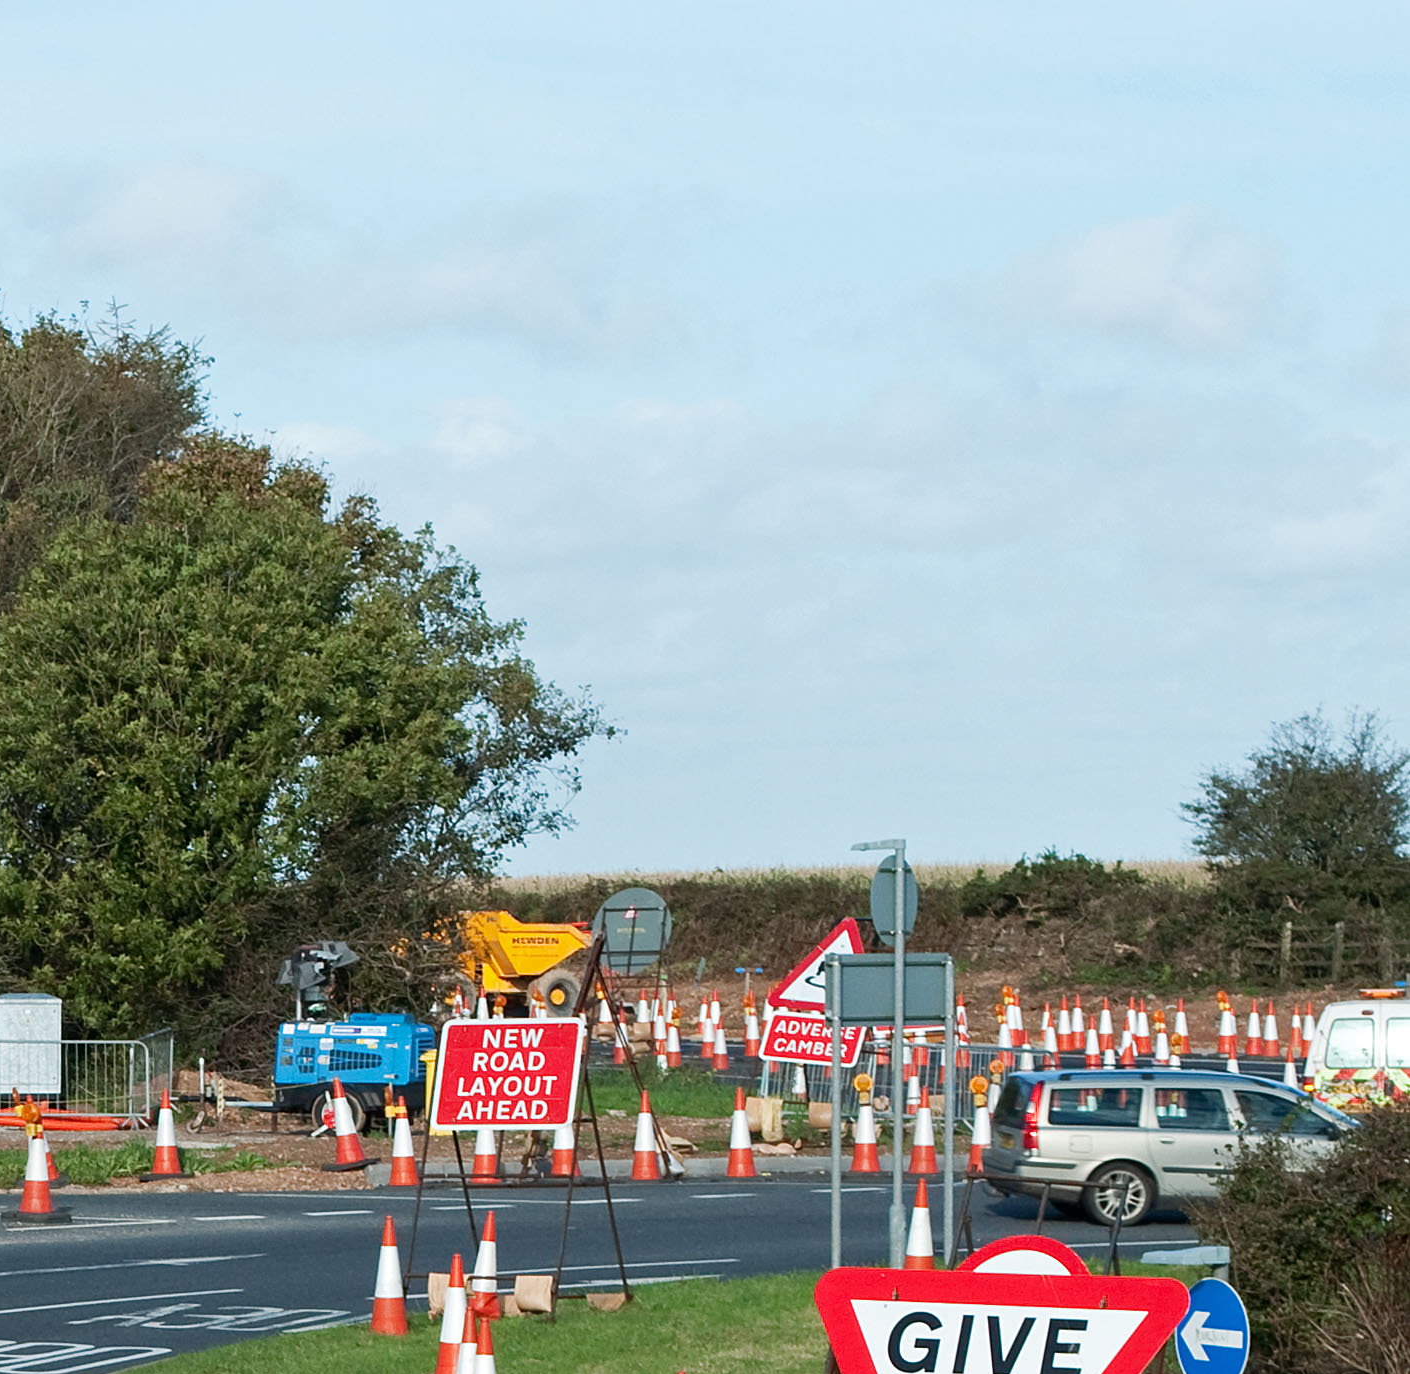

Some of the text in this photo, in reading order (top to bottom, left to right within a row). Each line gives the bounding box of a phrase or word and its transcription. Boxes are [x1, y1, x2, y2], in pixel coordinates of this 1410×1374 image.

[511, 937, 560, 945] HEWDEN
[482, 1028, 544, 1048] NEW
[774, 1020, 857, 1040] ADVERE
[472, 1051, 546, 1072] ROAD
[457, 1075, 558, 1096] LAYOUT
[456, 1100, 549, 1120] AHEAD
